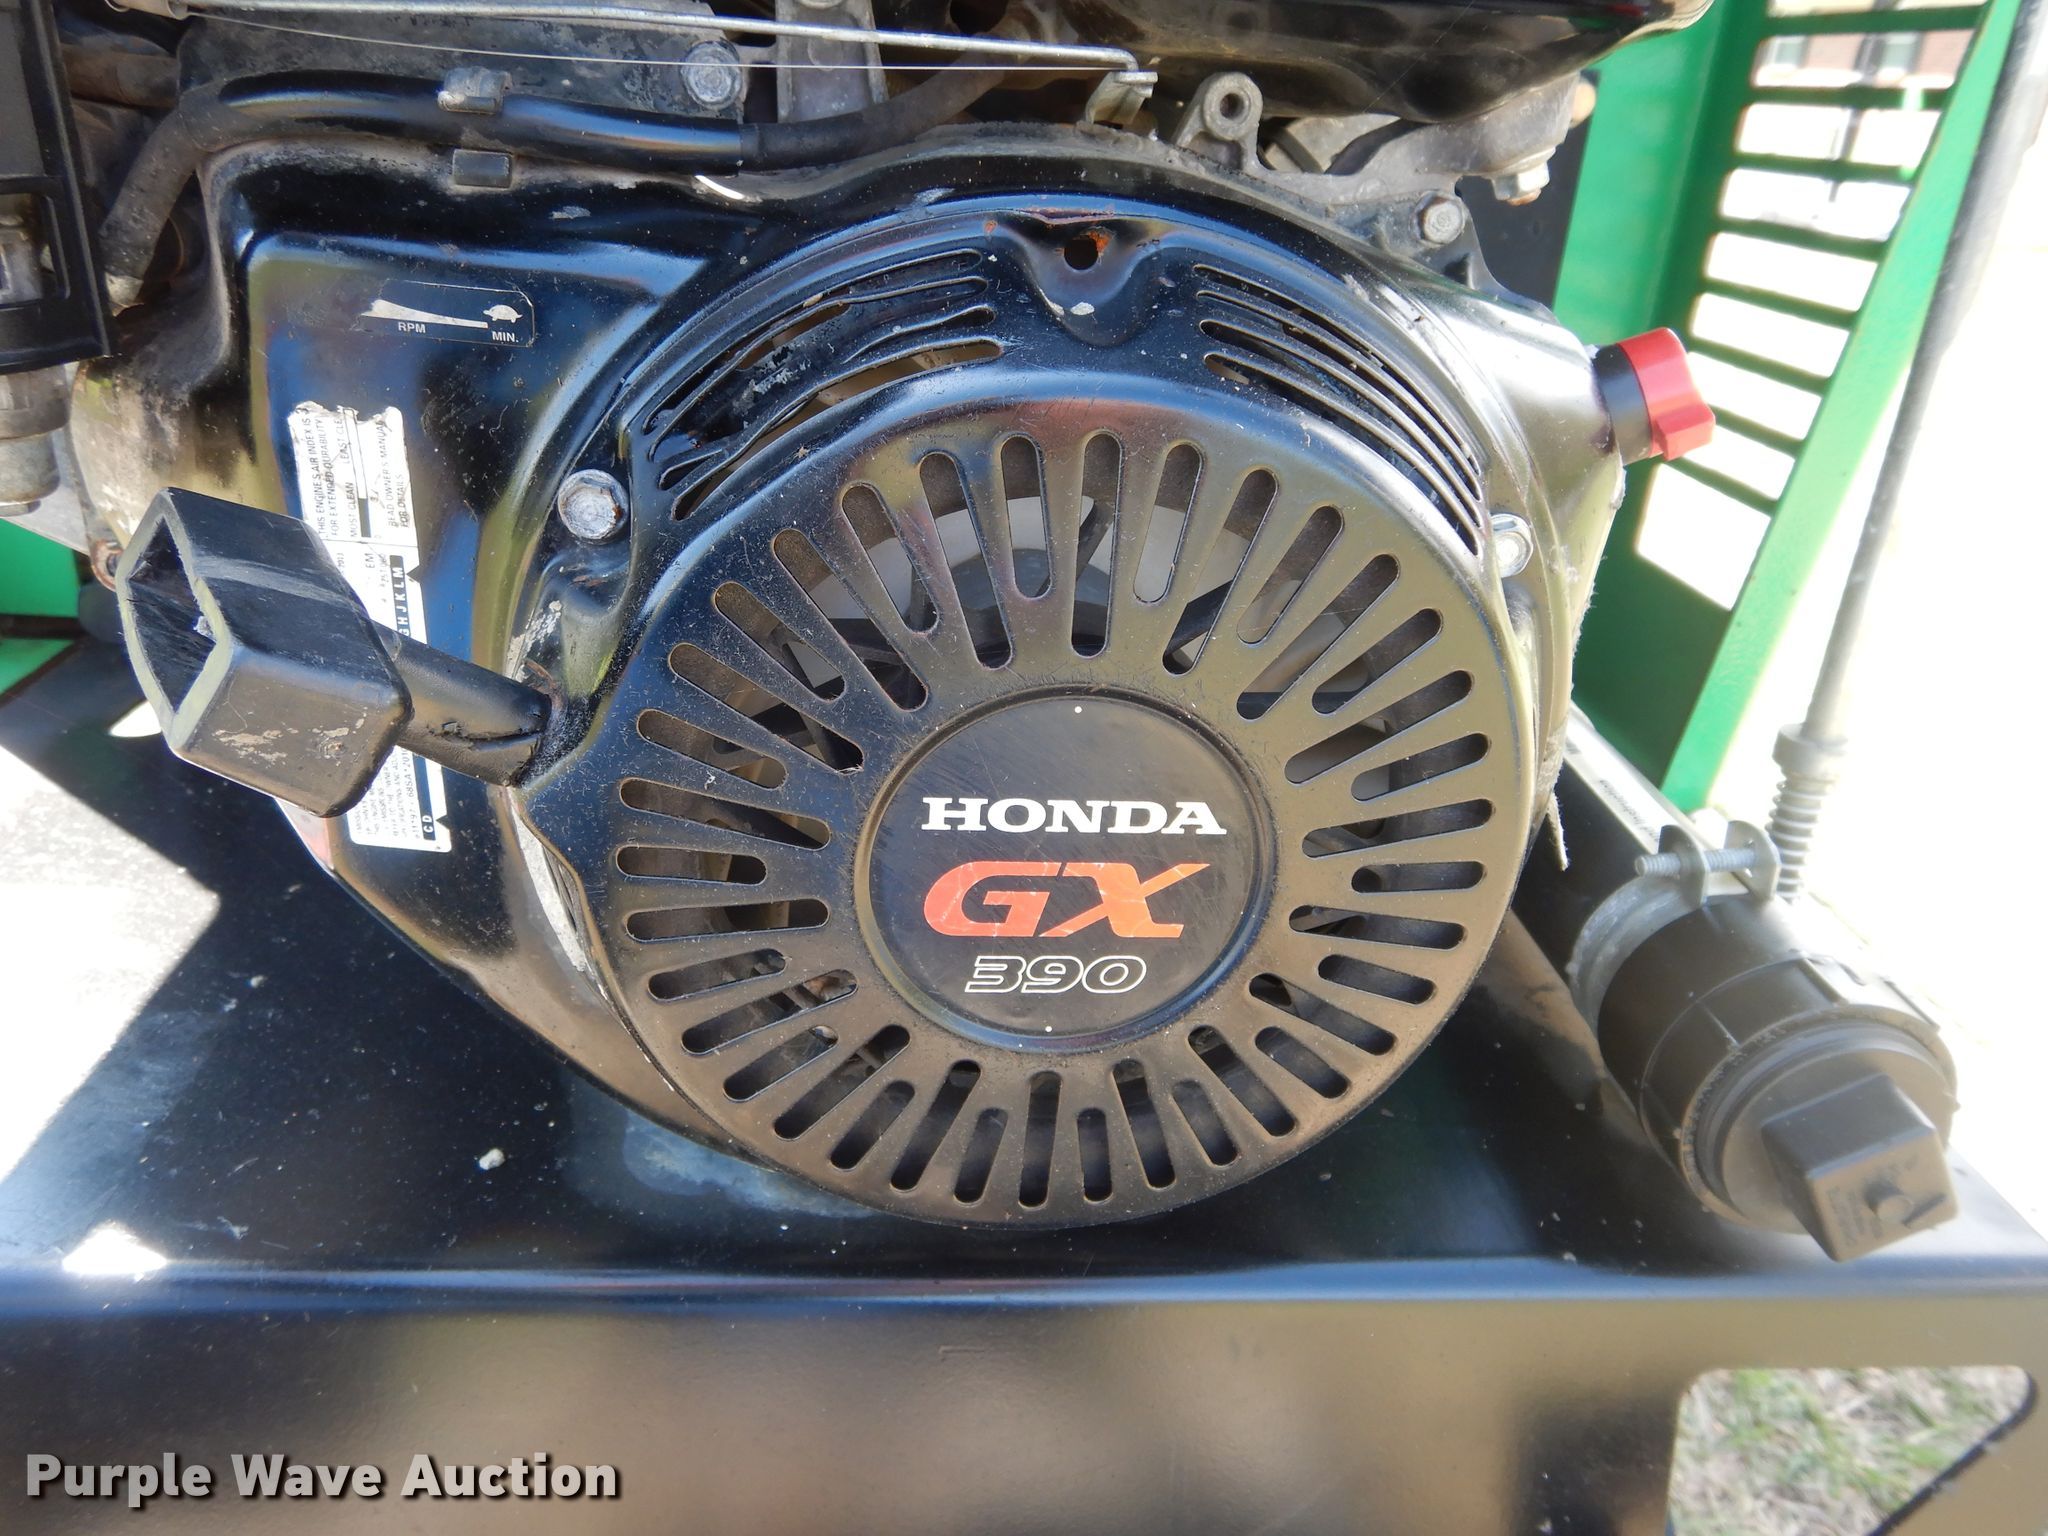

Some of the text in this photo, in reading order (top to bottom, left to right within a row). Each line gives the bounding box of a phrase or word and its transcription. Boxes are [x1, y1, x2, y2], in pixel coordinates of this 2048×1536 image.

[398, 322, 426, 334] RPM
[492, 331, 519, 343] MIN.
[302, 418, 311, 427] IS
[306, 430, 318, 457] INDEX
[310, 457, 321, 474] AIR
[346, 482, 357, 537] MOST CLEAN
[317, 514, 326, 534] THIS
[329, 517, 339, 535] FOR
[921, 797, 1227, 835] HONDA
[423, 825, 434, 833] C
[923, 860, 1211, 938] GX
[964, 955, 1147, 994] 390
